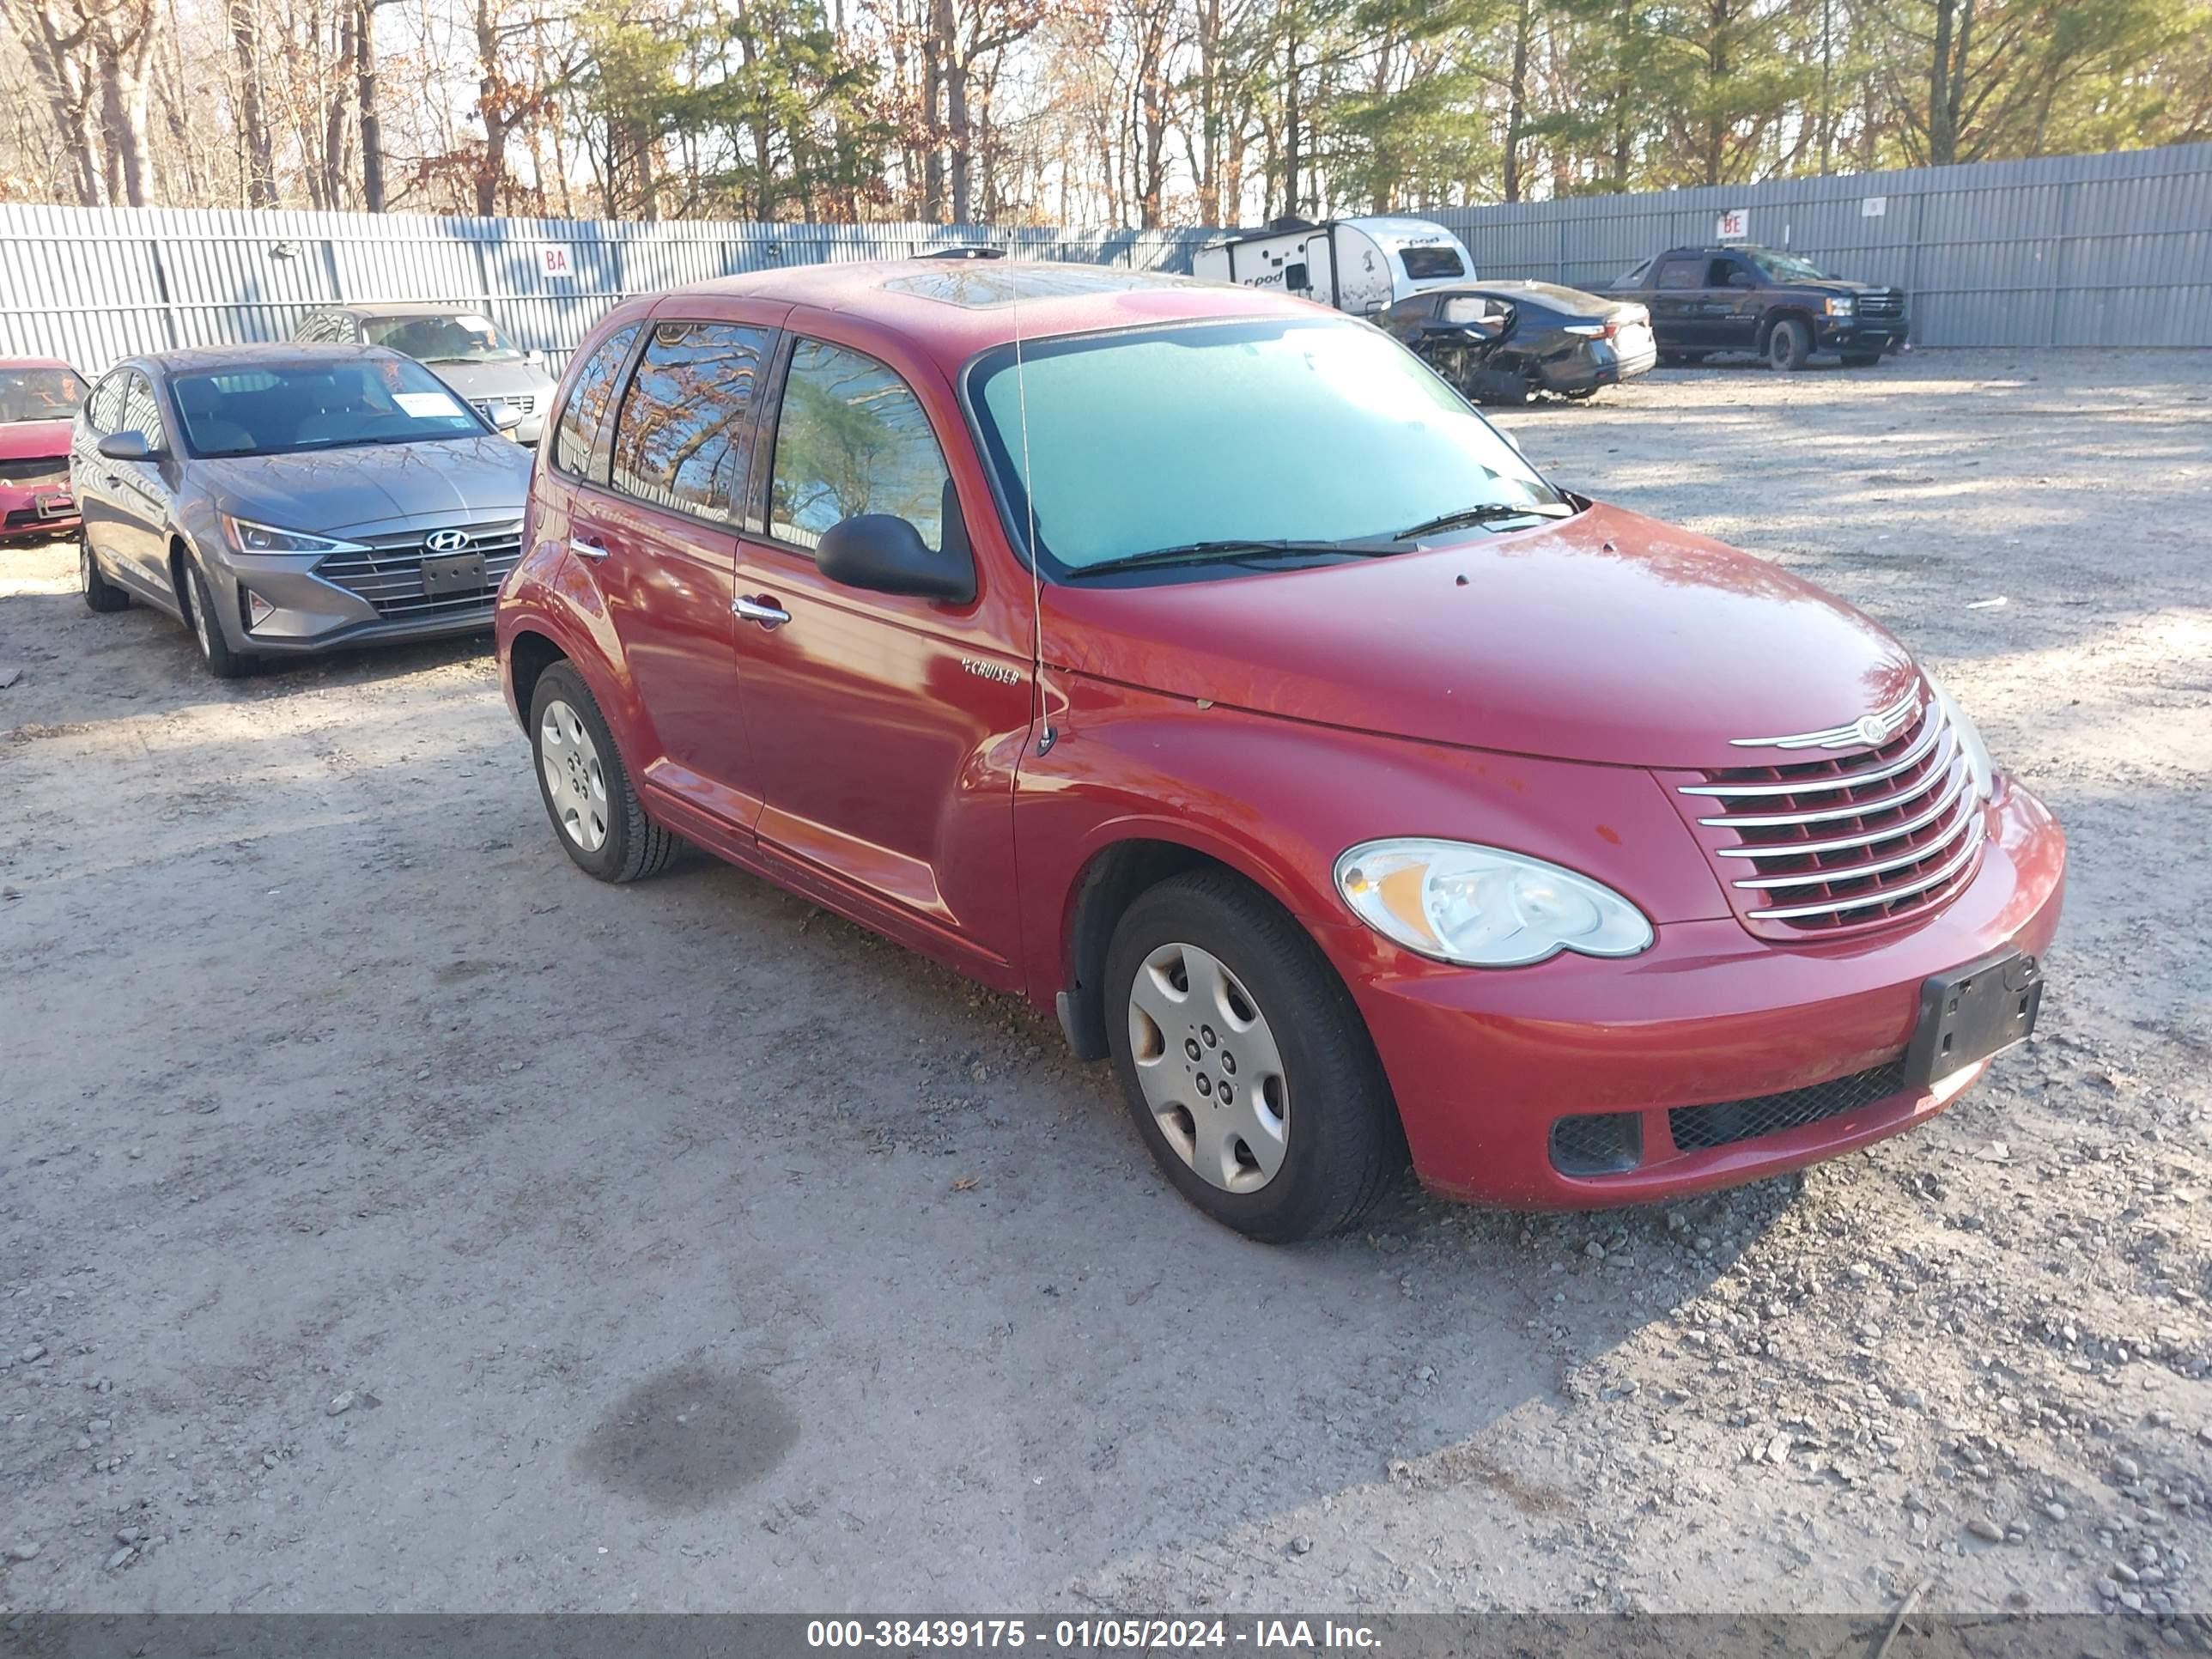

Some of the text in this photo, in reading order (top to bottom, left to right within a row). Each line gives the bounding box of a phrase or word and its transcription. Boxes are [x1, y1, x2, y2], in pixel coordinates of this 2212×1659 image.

[1723, 216, 1741, 234] BE
[546, 251, 567, 270] BA
[971, 660, 1020, 686] CRUISER
